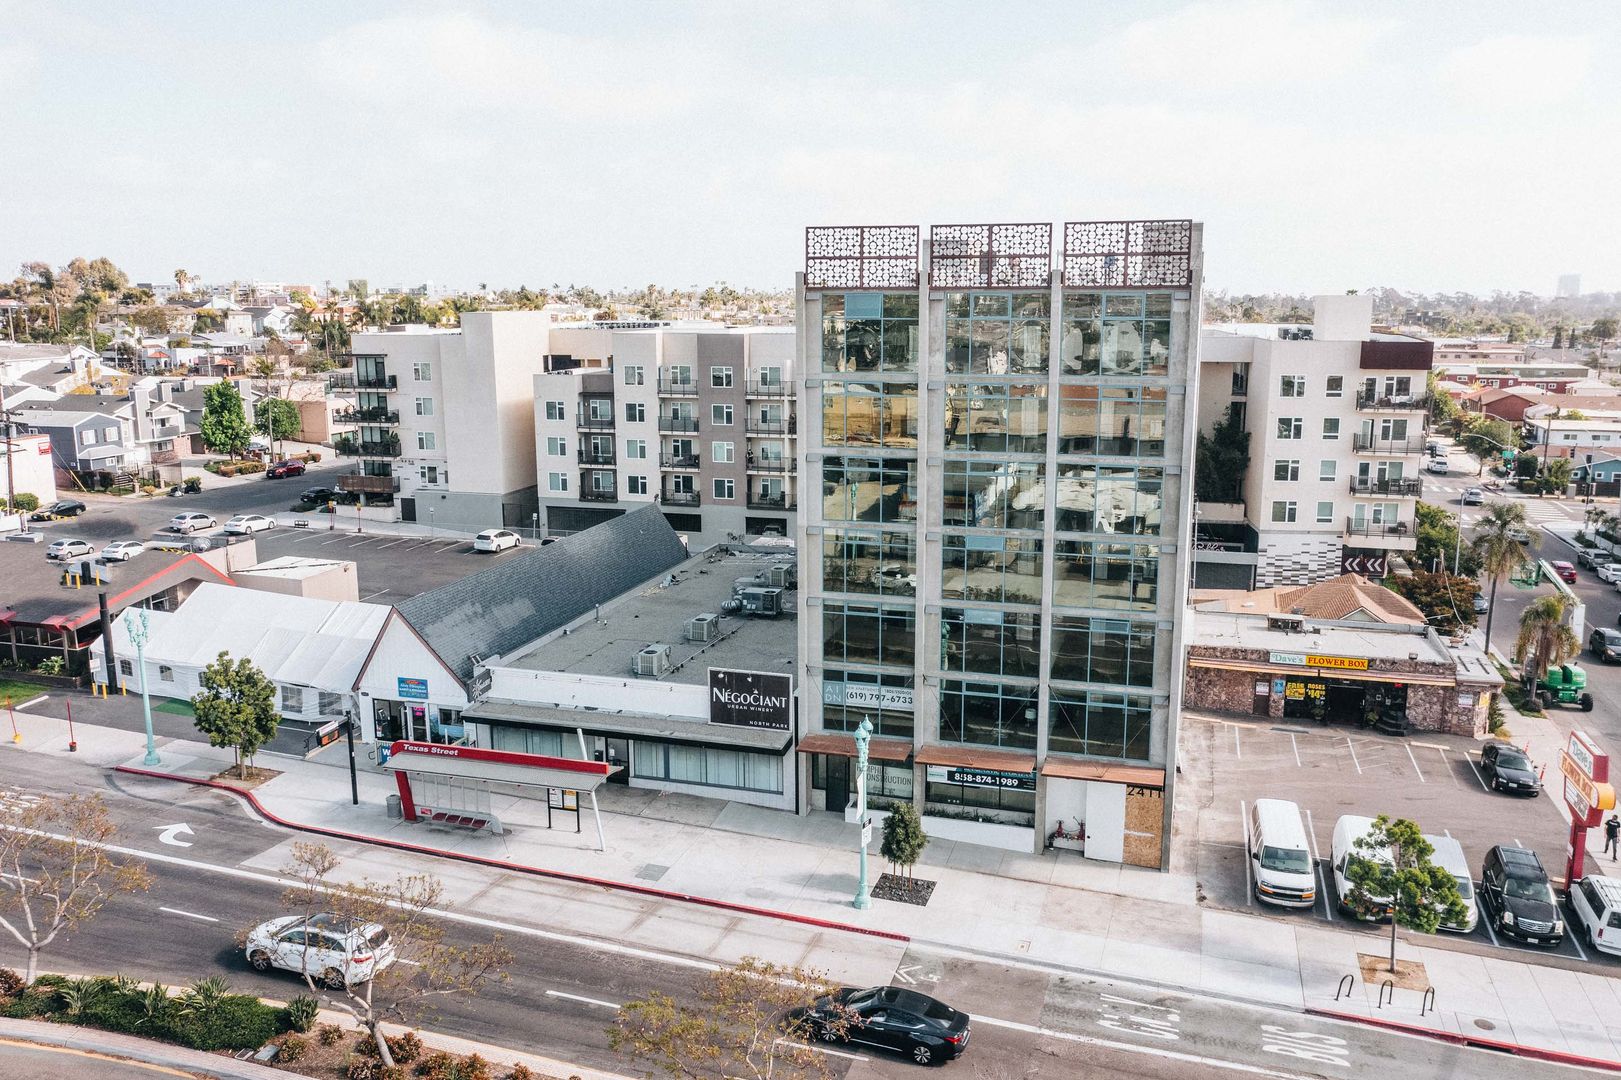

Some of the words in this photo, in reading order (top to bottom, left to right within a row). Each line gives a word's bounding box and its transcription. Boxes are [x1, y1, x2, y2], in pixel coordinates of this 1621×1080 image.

[1308, 657, 1346, 667] FLOWER
[1347, 660, 1367, 668] BOX
[713, 687, 788, 708] NÉGOCIANT
[846, 691, 867, 702] (619)
[869, 693, 913, 705] 797-6733
[403, 744, 429, 753] Texas
[430, 747, 459, 756] Street
[954, 772, 1019, 787] 858-874-1989
[1127, 786, 1161, 799] 2411
[1261, 1024, 1351, 1067] BUS
